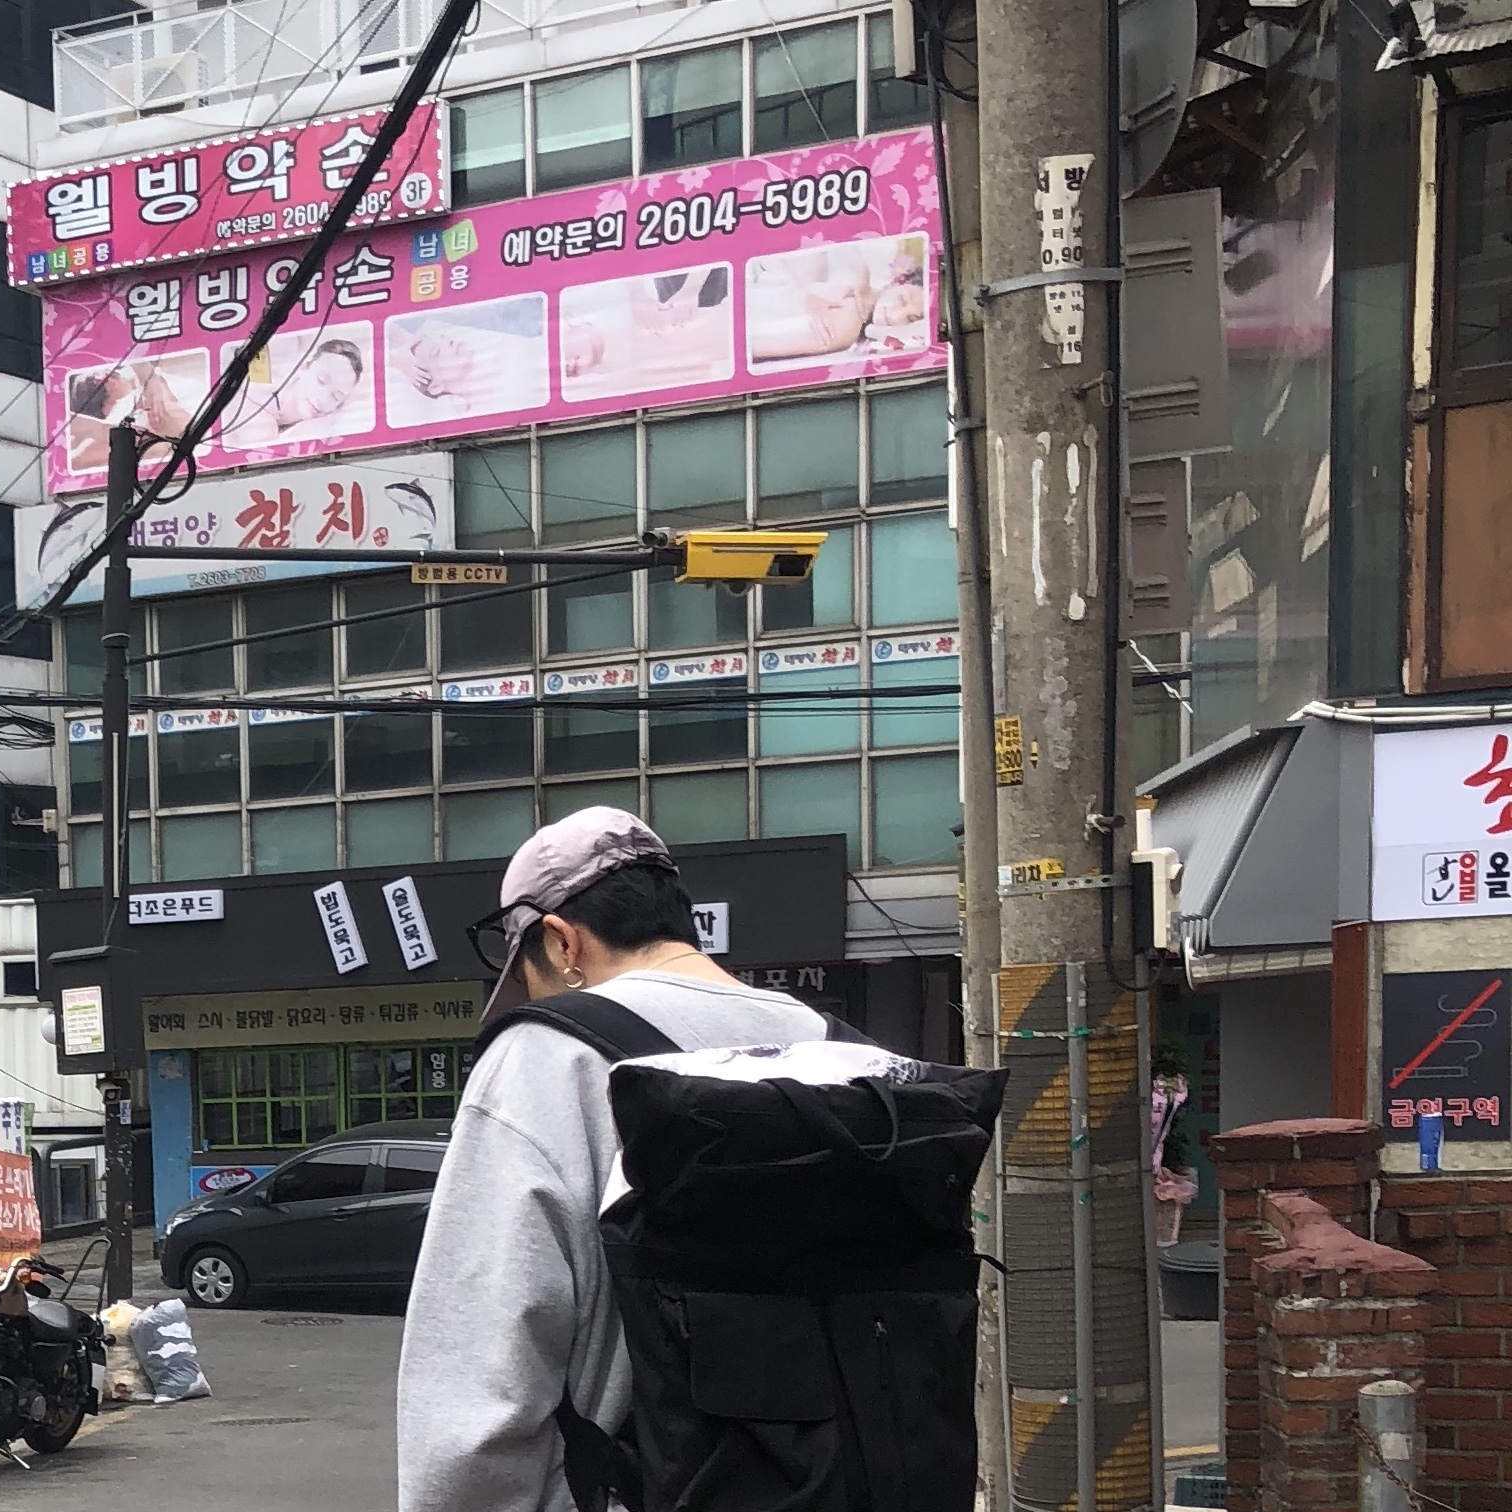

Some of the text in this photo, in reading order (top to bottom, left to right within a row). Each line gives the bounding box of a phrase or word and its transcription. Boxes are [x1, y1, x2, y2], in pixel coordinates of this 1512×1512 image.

[405, 178, 427, 203] 3F
[217, 212, 276, 238] 예약문의
[503, 167, 870, 265] 예약문의 2604-5989
[31, 243, 110, 274] 남녀공용
[417, 567, 503, 581] 방범용 CCTV
[434, 1000, 474, 1020] 식사류
[1389, 1095, 1500, 1128] 금연구역
